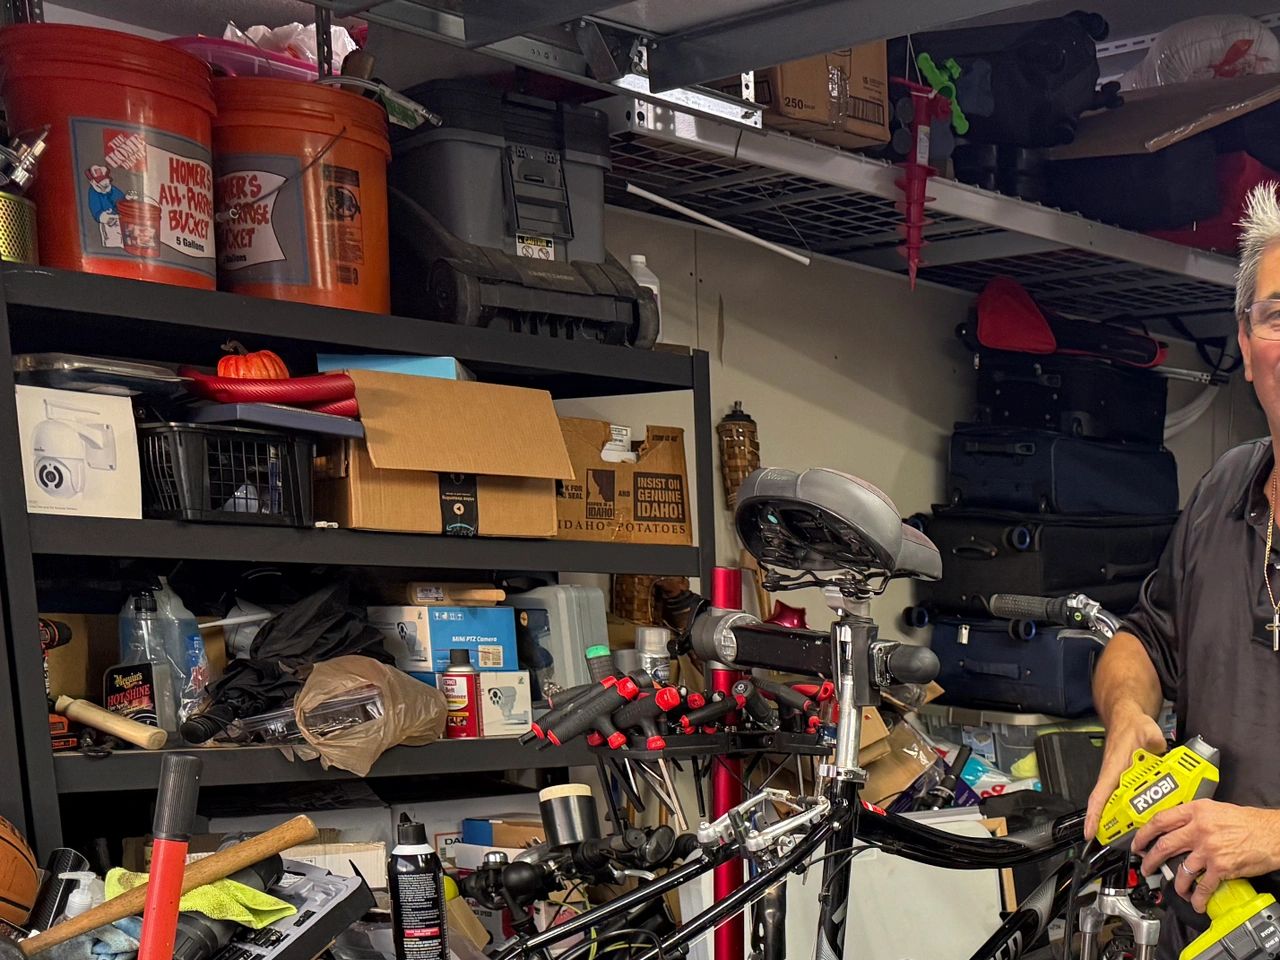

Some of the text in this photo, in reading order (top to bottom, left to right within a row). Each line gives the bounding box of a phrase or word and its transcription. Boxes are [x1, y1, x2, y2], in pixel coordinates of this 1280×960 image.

[784, 97, 803, 110] 250
[168, 210, 209, 240] BUCKET
[176, 236, 204, 252] 5 Gallons
[637, 477, 666, 488] INSIST
[638, 489, 681, 502] GENUINE
[588, 507, 612, 518] IDAHO
[637, 502, 683, 518] IDAHO!
[618, 523, 686, 534] POTATOES
[125, 684, 151, 701] SHINE
[1133, 776, 1175, 811] RYOBI
